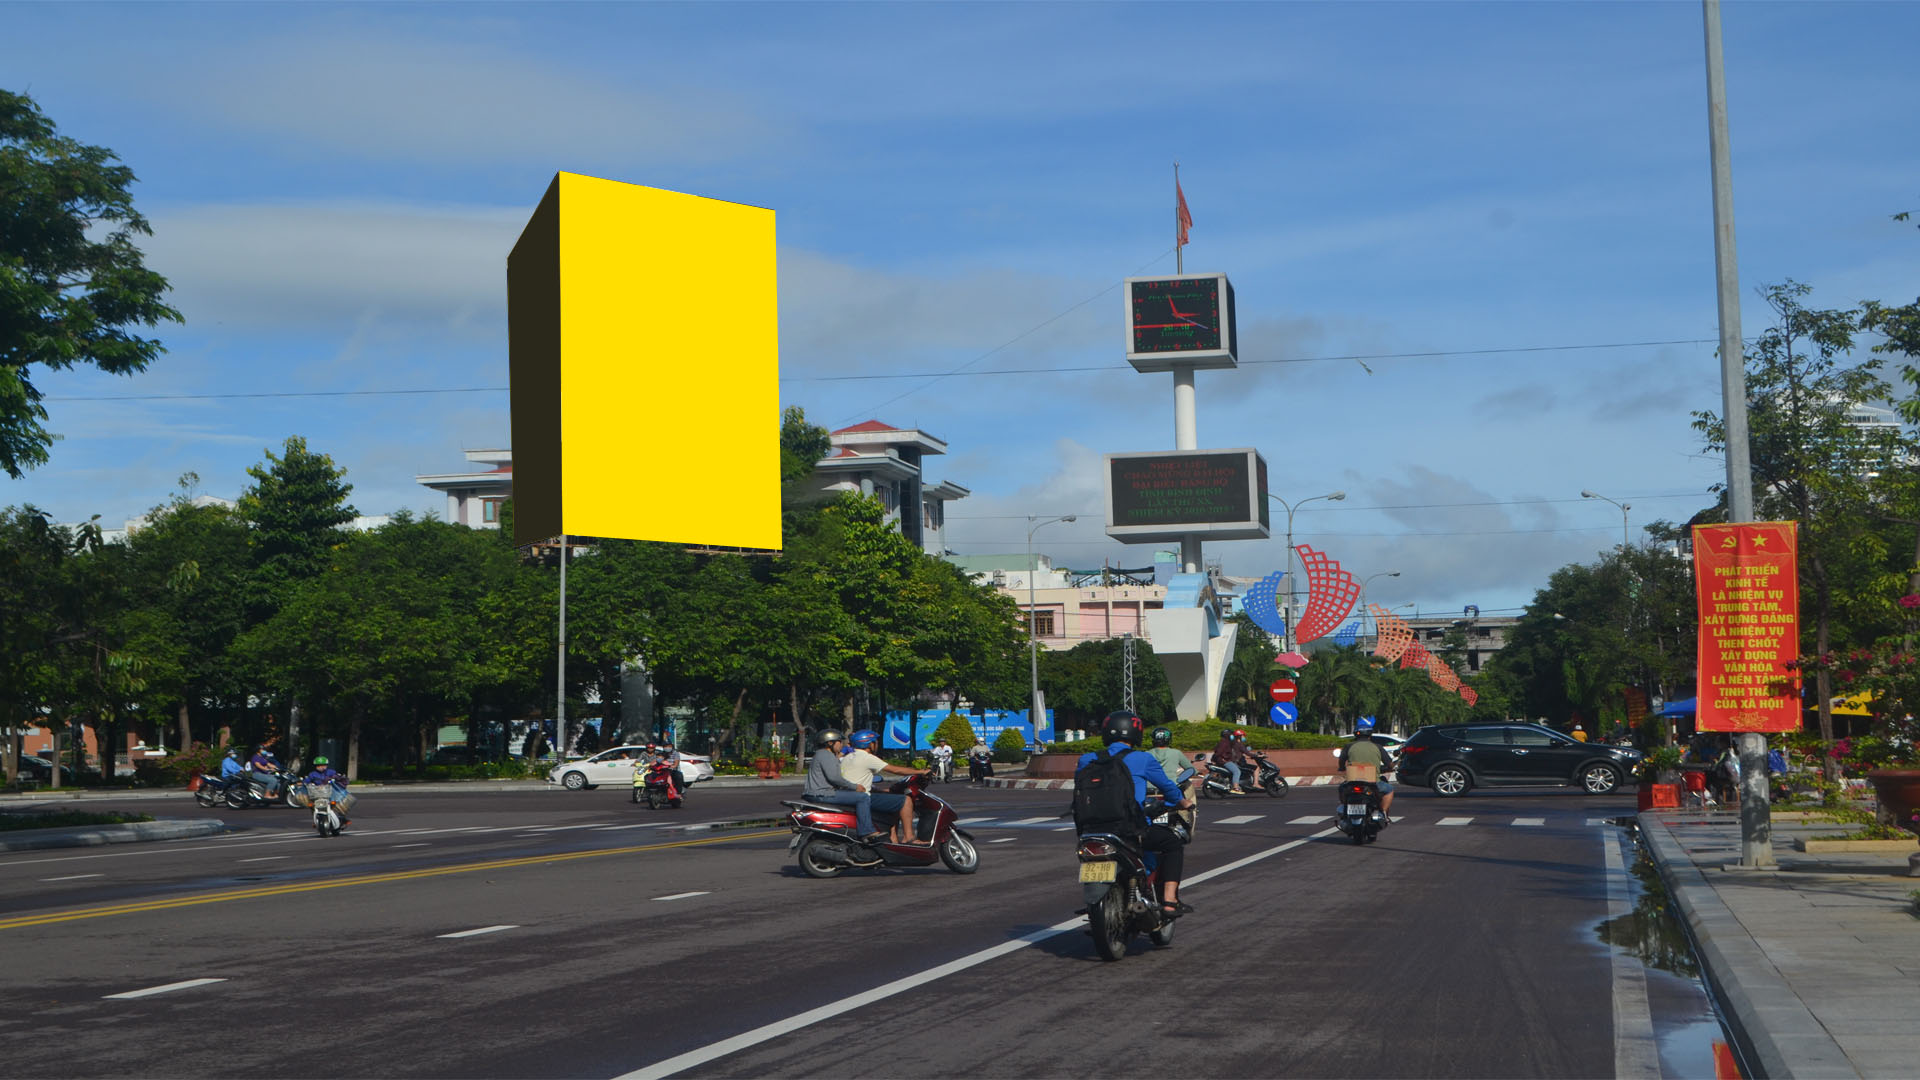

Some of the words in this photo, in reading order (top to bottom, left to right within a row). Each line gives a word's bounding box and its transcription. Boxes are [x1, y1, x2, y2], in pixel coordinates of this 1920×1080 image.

[1714, 565, 1742, 576] PHÁT
[1744, 562, 1779, 575] TRIỂN
[1726, 578, 1752, 588] KINH
[1754, 576, 1768, 587] TẾ
[1712, 590, 1726, 600] LÀ
[1728, 588, 1765, 601] NHIỆM
[1768, 590, 1784, 601] VỤ
[1714, 602, 1750, 612] TRUNG
[1752, 600, 1782, 612] TÂM,
[1704, 614, 1725, 624] XÂY
[1728, 614, 1758, 626] DỰNG
[1761, 612, 1794, 623] ĐẢNG
[1713, 626, 1726, 636] LÀ
[1729, 625, 1766, 638] NHIỆM
[1769, 626, 1784, 637] VỤ
[1718, 639, 1745, 648] THEN
[1748, 636, 1780, 648] CHỐT,
[1721, 650, 1741, 660] XÂY
[1744, 650, 1777, 661] DỰNG
[1724, 662, 1746, 672] VĂN
[1750, 662, 1774, 672] HÓA
[1712, 674, 1726, 684] LÀ
[1728, 672, 1752, 684] NỀN
[1719, 688, 1745, 696] TINH
[1714, 697, 1737, 708] CỦA
[1741, 698, 1756, 708] XÃ
[1760, 698, 1784, 710] HỘI!
